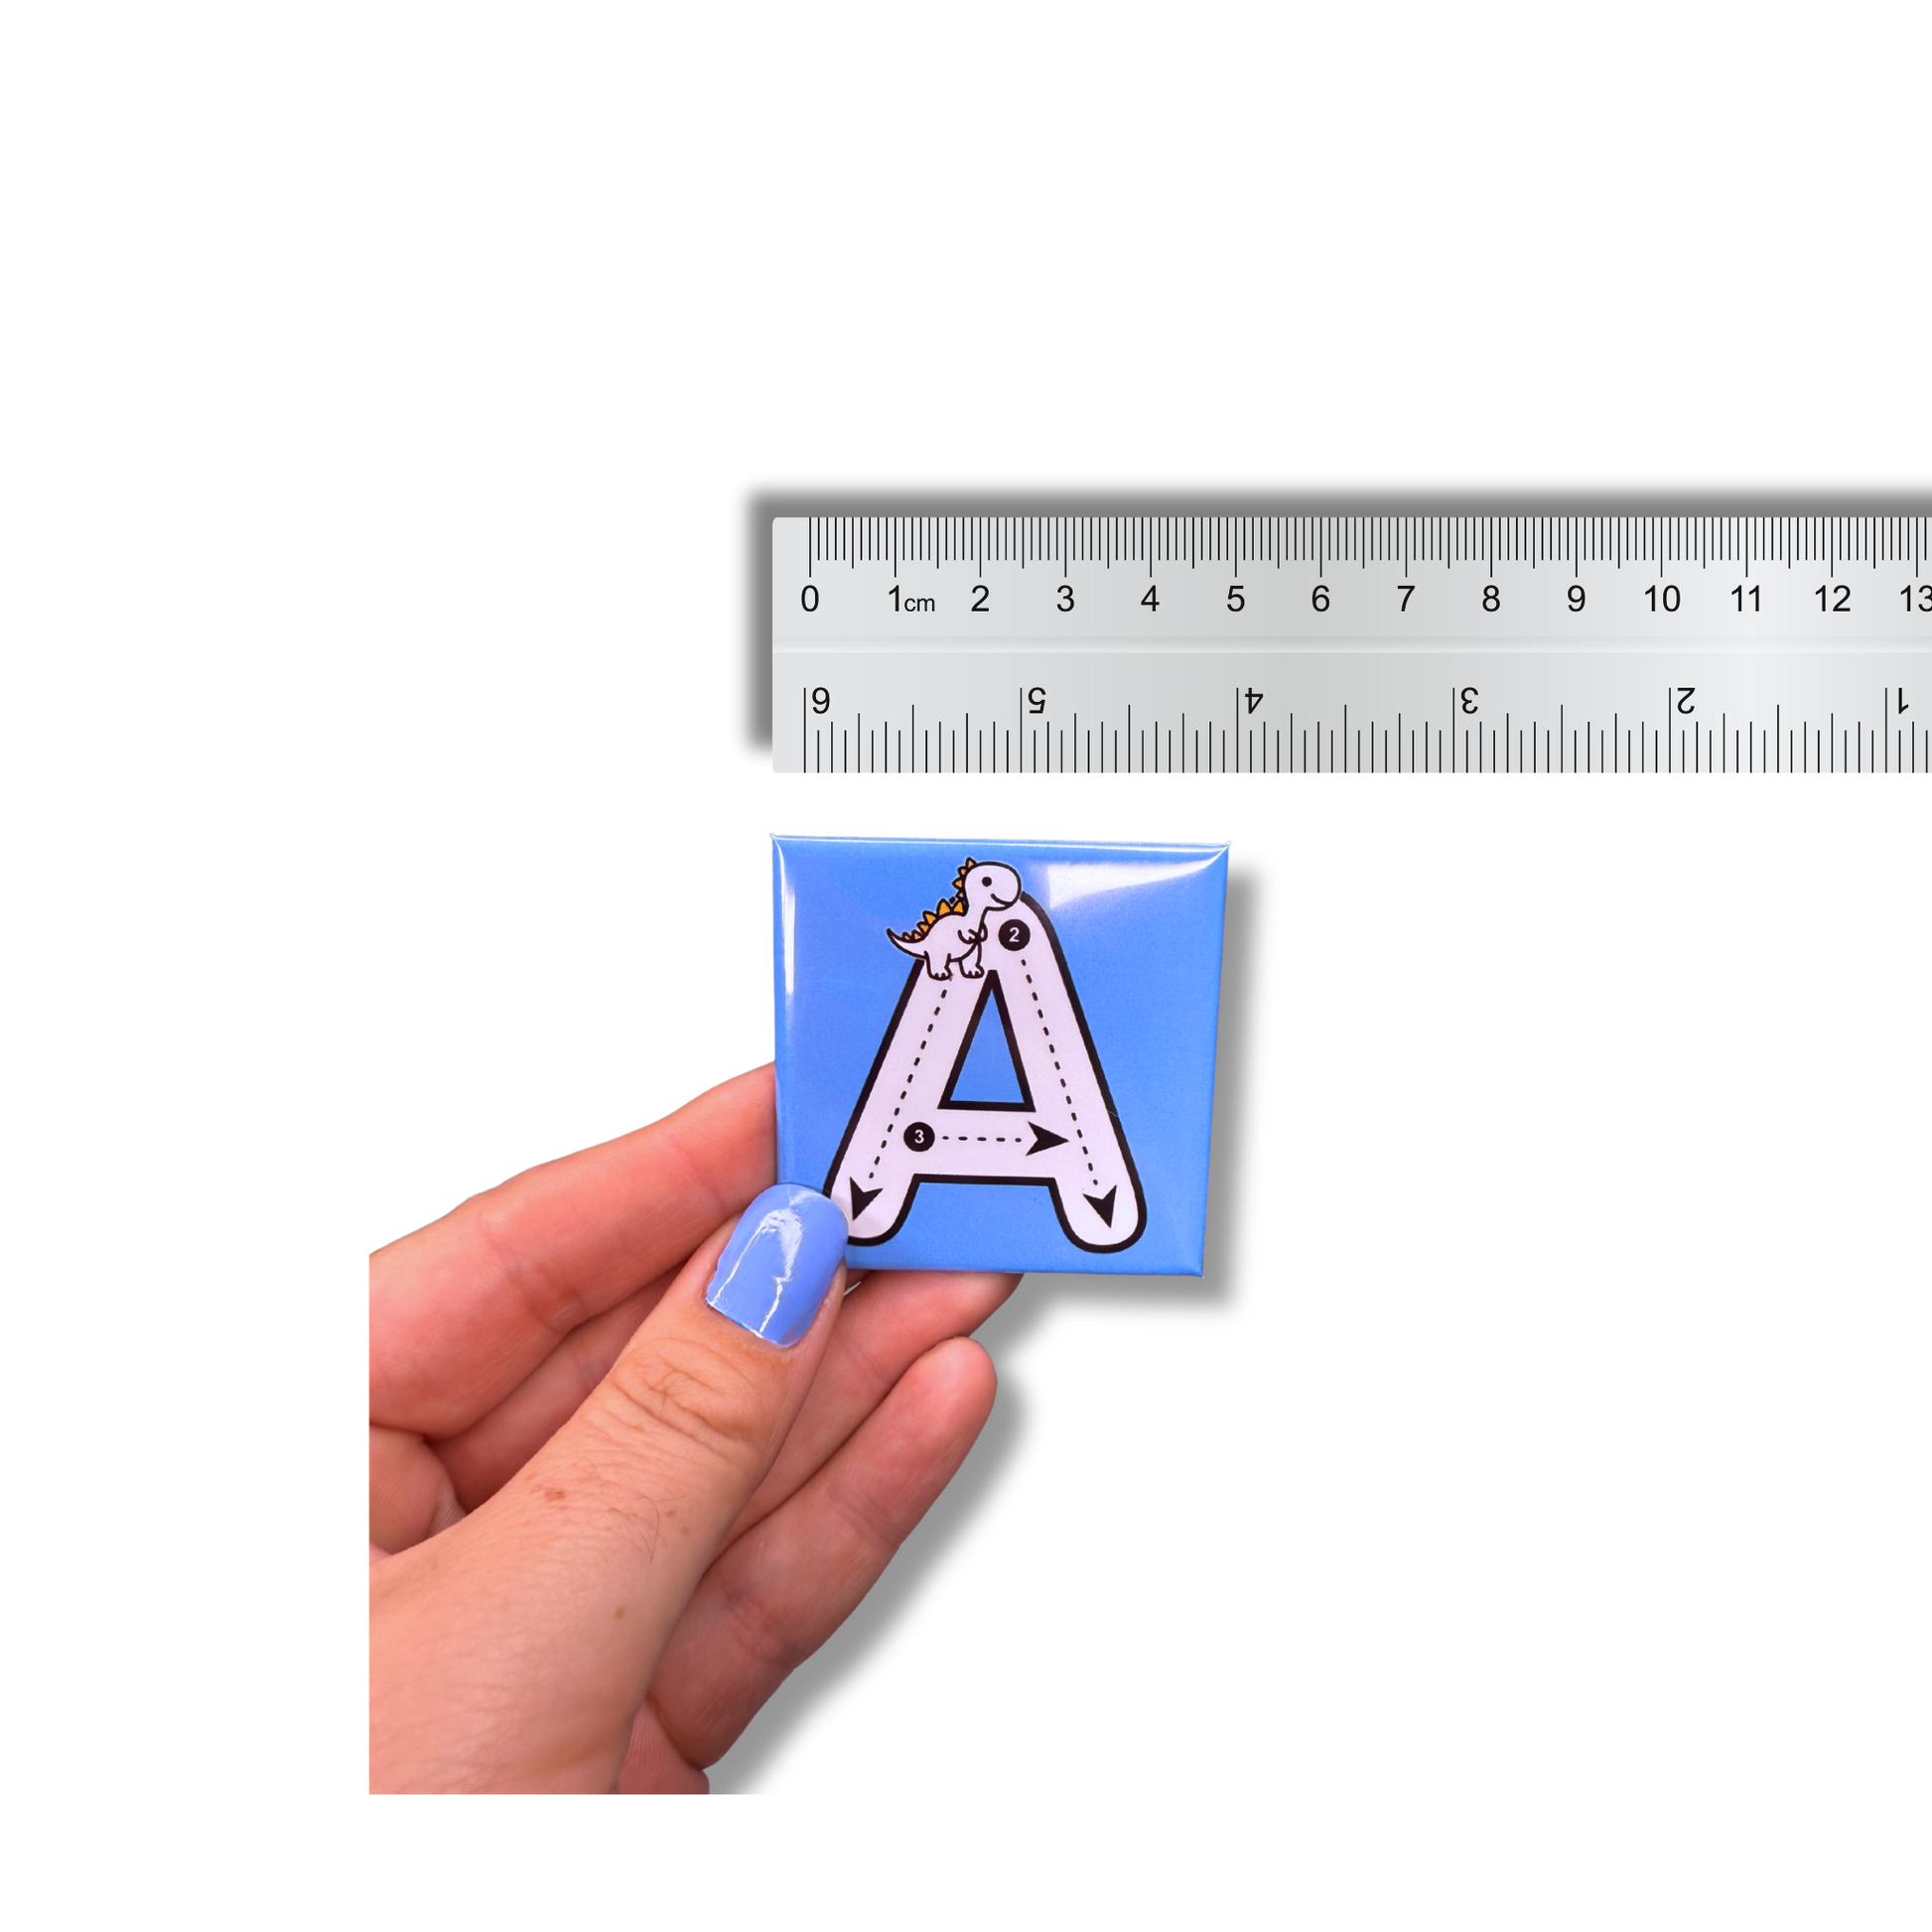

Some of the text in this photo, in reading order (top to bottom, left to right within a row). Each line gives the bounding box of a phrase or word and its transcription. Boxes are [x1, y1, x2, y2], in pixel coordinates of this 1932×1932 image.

[800, 584, 819, 613] 0
[971, 584, 990, 613] 2
[1056, 584, 1075, 613] 3
[1141, 584, 1161, 613] 4
[1226, 584, 1245, 613] 5
[1311, 584, 1330, 613] 6
[1397, 584, 1416, 613] 7
[1482, 584, 1501, 613] 8
[1567, 584, 1586, 613] 9
[1644, 584, 1681, 613] 10
[1730, 584, 1761, 613] 11
[1815, 584, 1851, 613] 12
[1900, 584, 1932, 613] 13
[1028, 686, 1046, 715] 5
[1244, 686, 1264, 715] 4
[1460, 686, 1479, 715] 3
[1677, 686, 1696, 715] 2
[1898, 687, 1909, 715] 1
[1008, 926, 1020, 942] 2
[822, 889, 1148, 1254] A
[914, 1129, 925, 1145] 3
